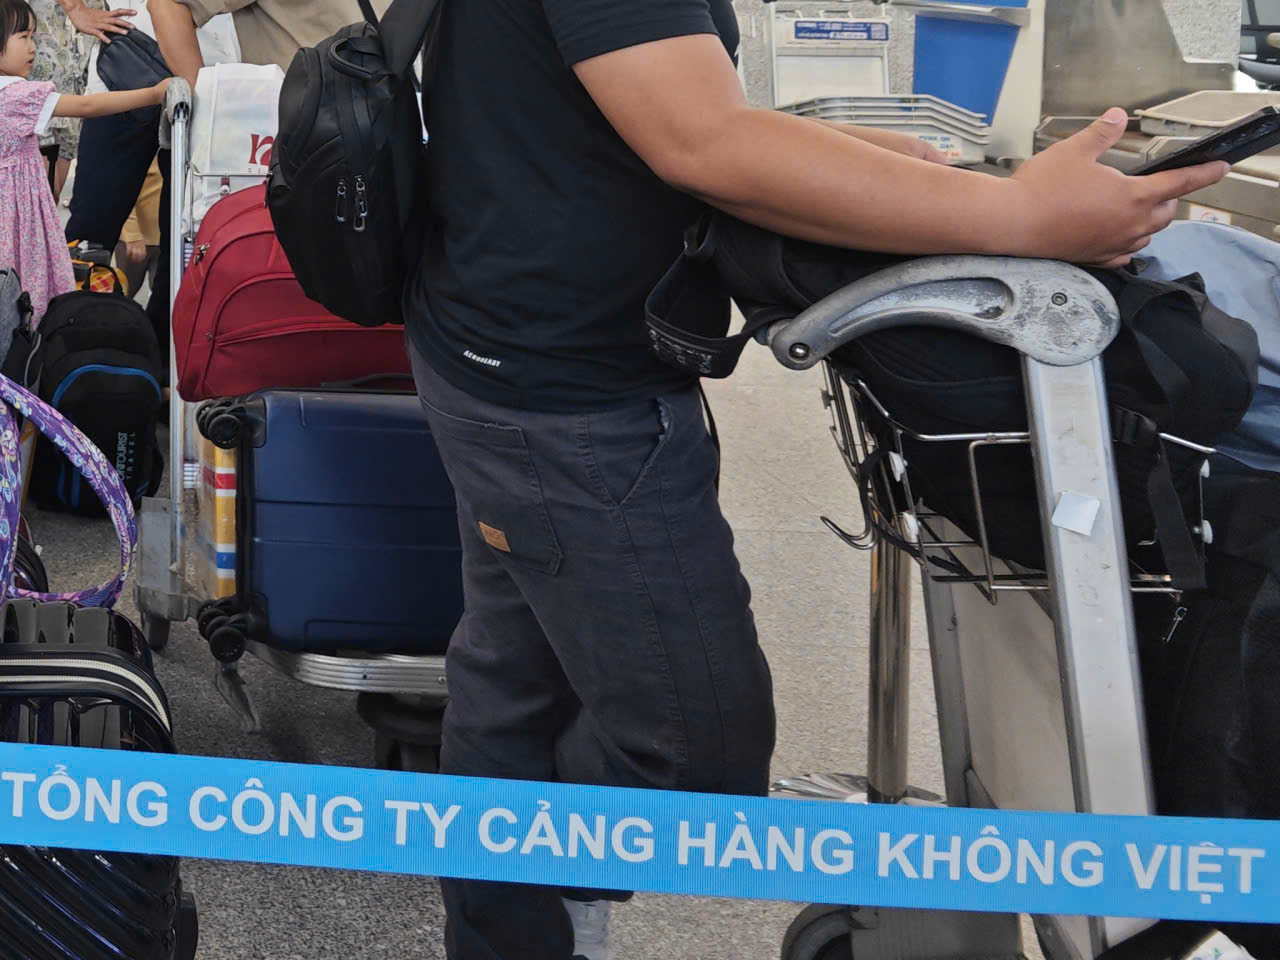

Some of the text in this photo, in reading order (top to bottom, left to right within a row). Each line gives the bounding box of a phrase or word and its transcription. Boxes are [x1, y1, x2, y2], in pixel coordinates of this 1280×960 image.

[1, 763, 1266, 904] TỔNG CÔNG TY CẢNG HÀNG KHÔNG VIỆT
